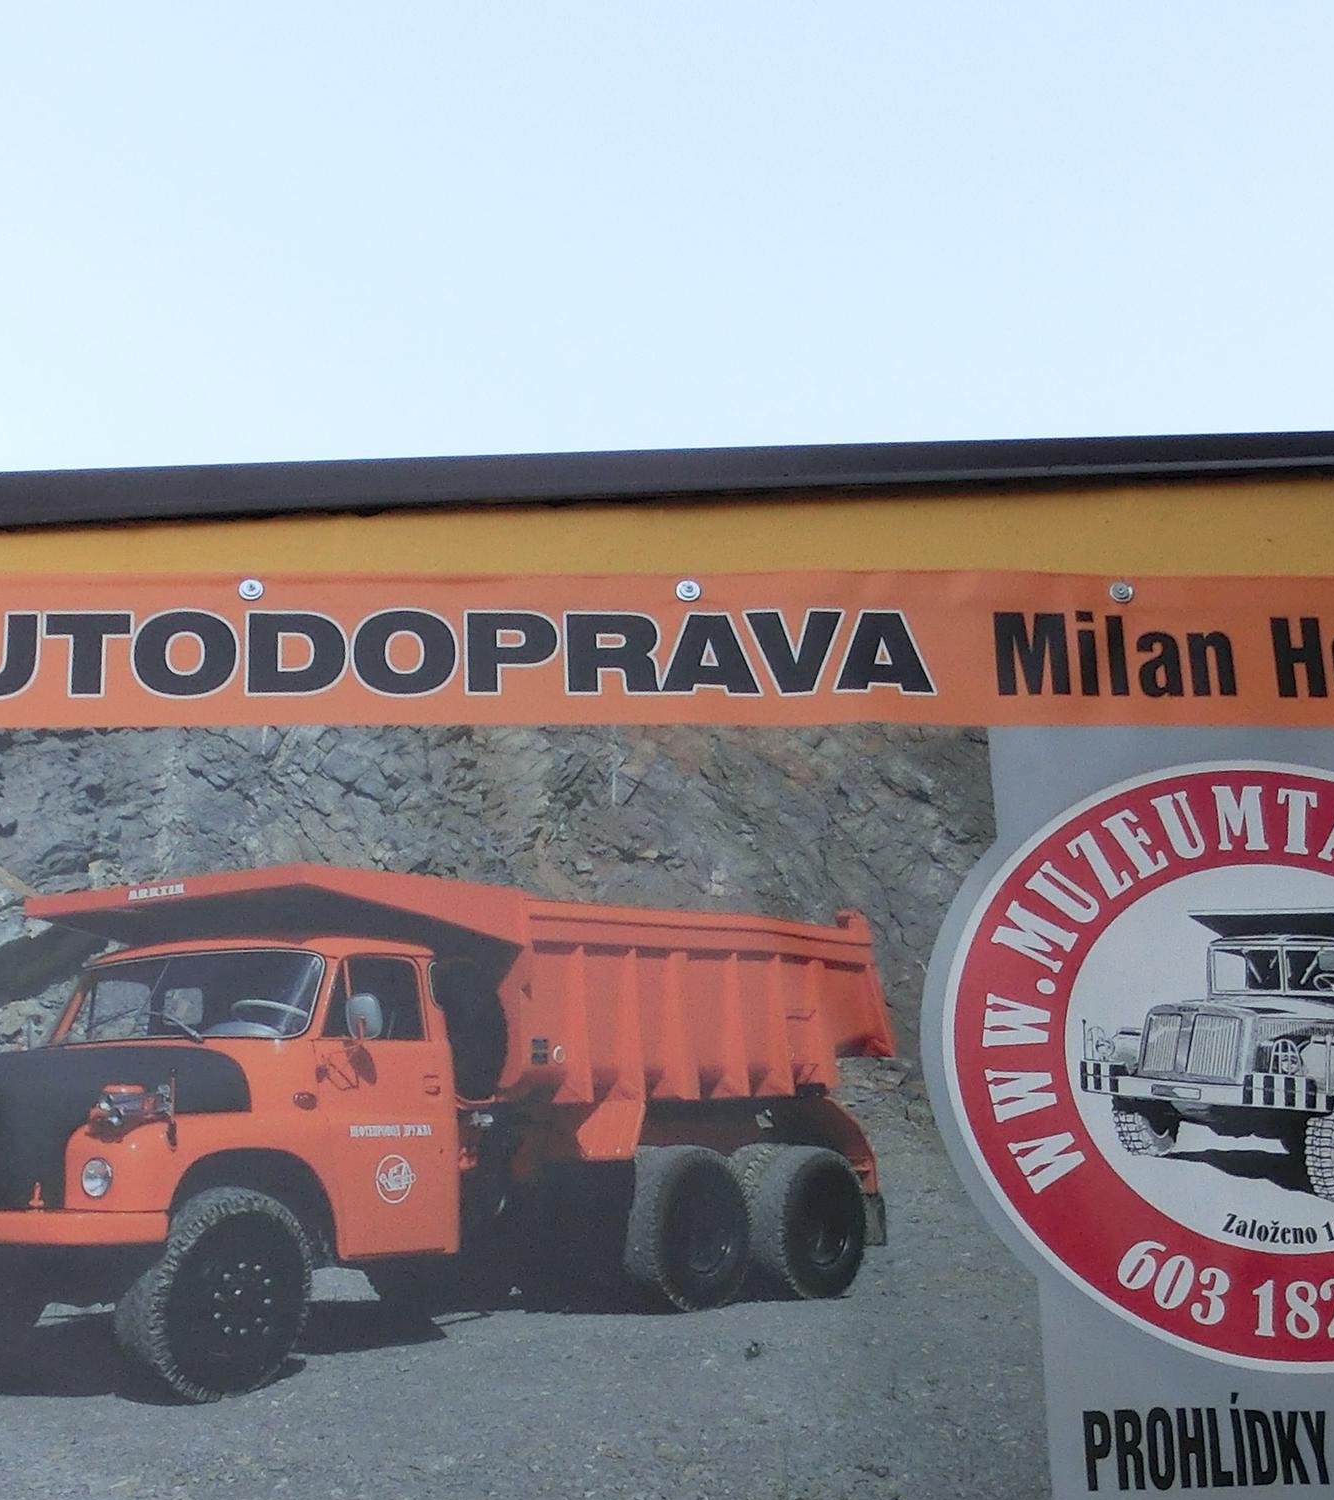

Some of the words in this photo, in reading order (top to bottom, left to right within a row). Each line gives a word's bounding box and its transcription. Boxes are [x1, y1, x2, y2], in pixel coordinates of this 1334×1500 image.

[993, 609, 1238, 699] Milan
[1223, 1212, 1318, 1246] Založeno
[1117, 1240, 1231, 1326] 603
[1082, 1392, 1331, 1491] PROHLÍDKY
